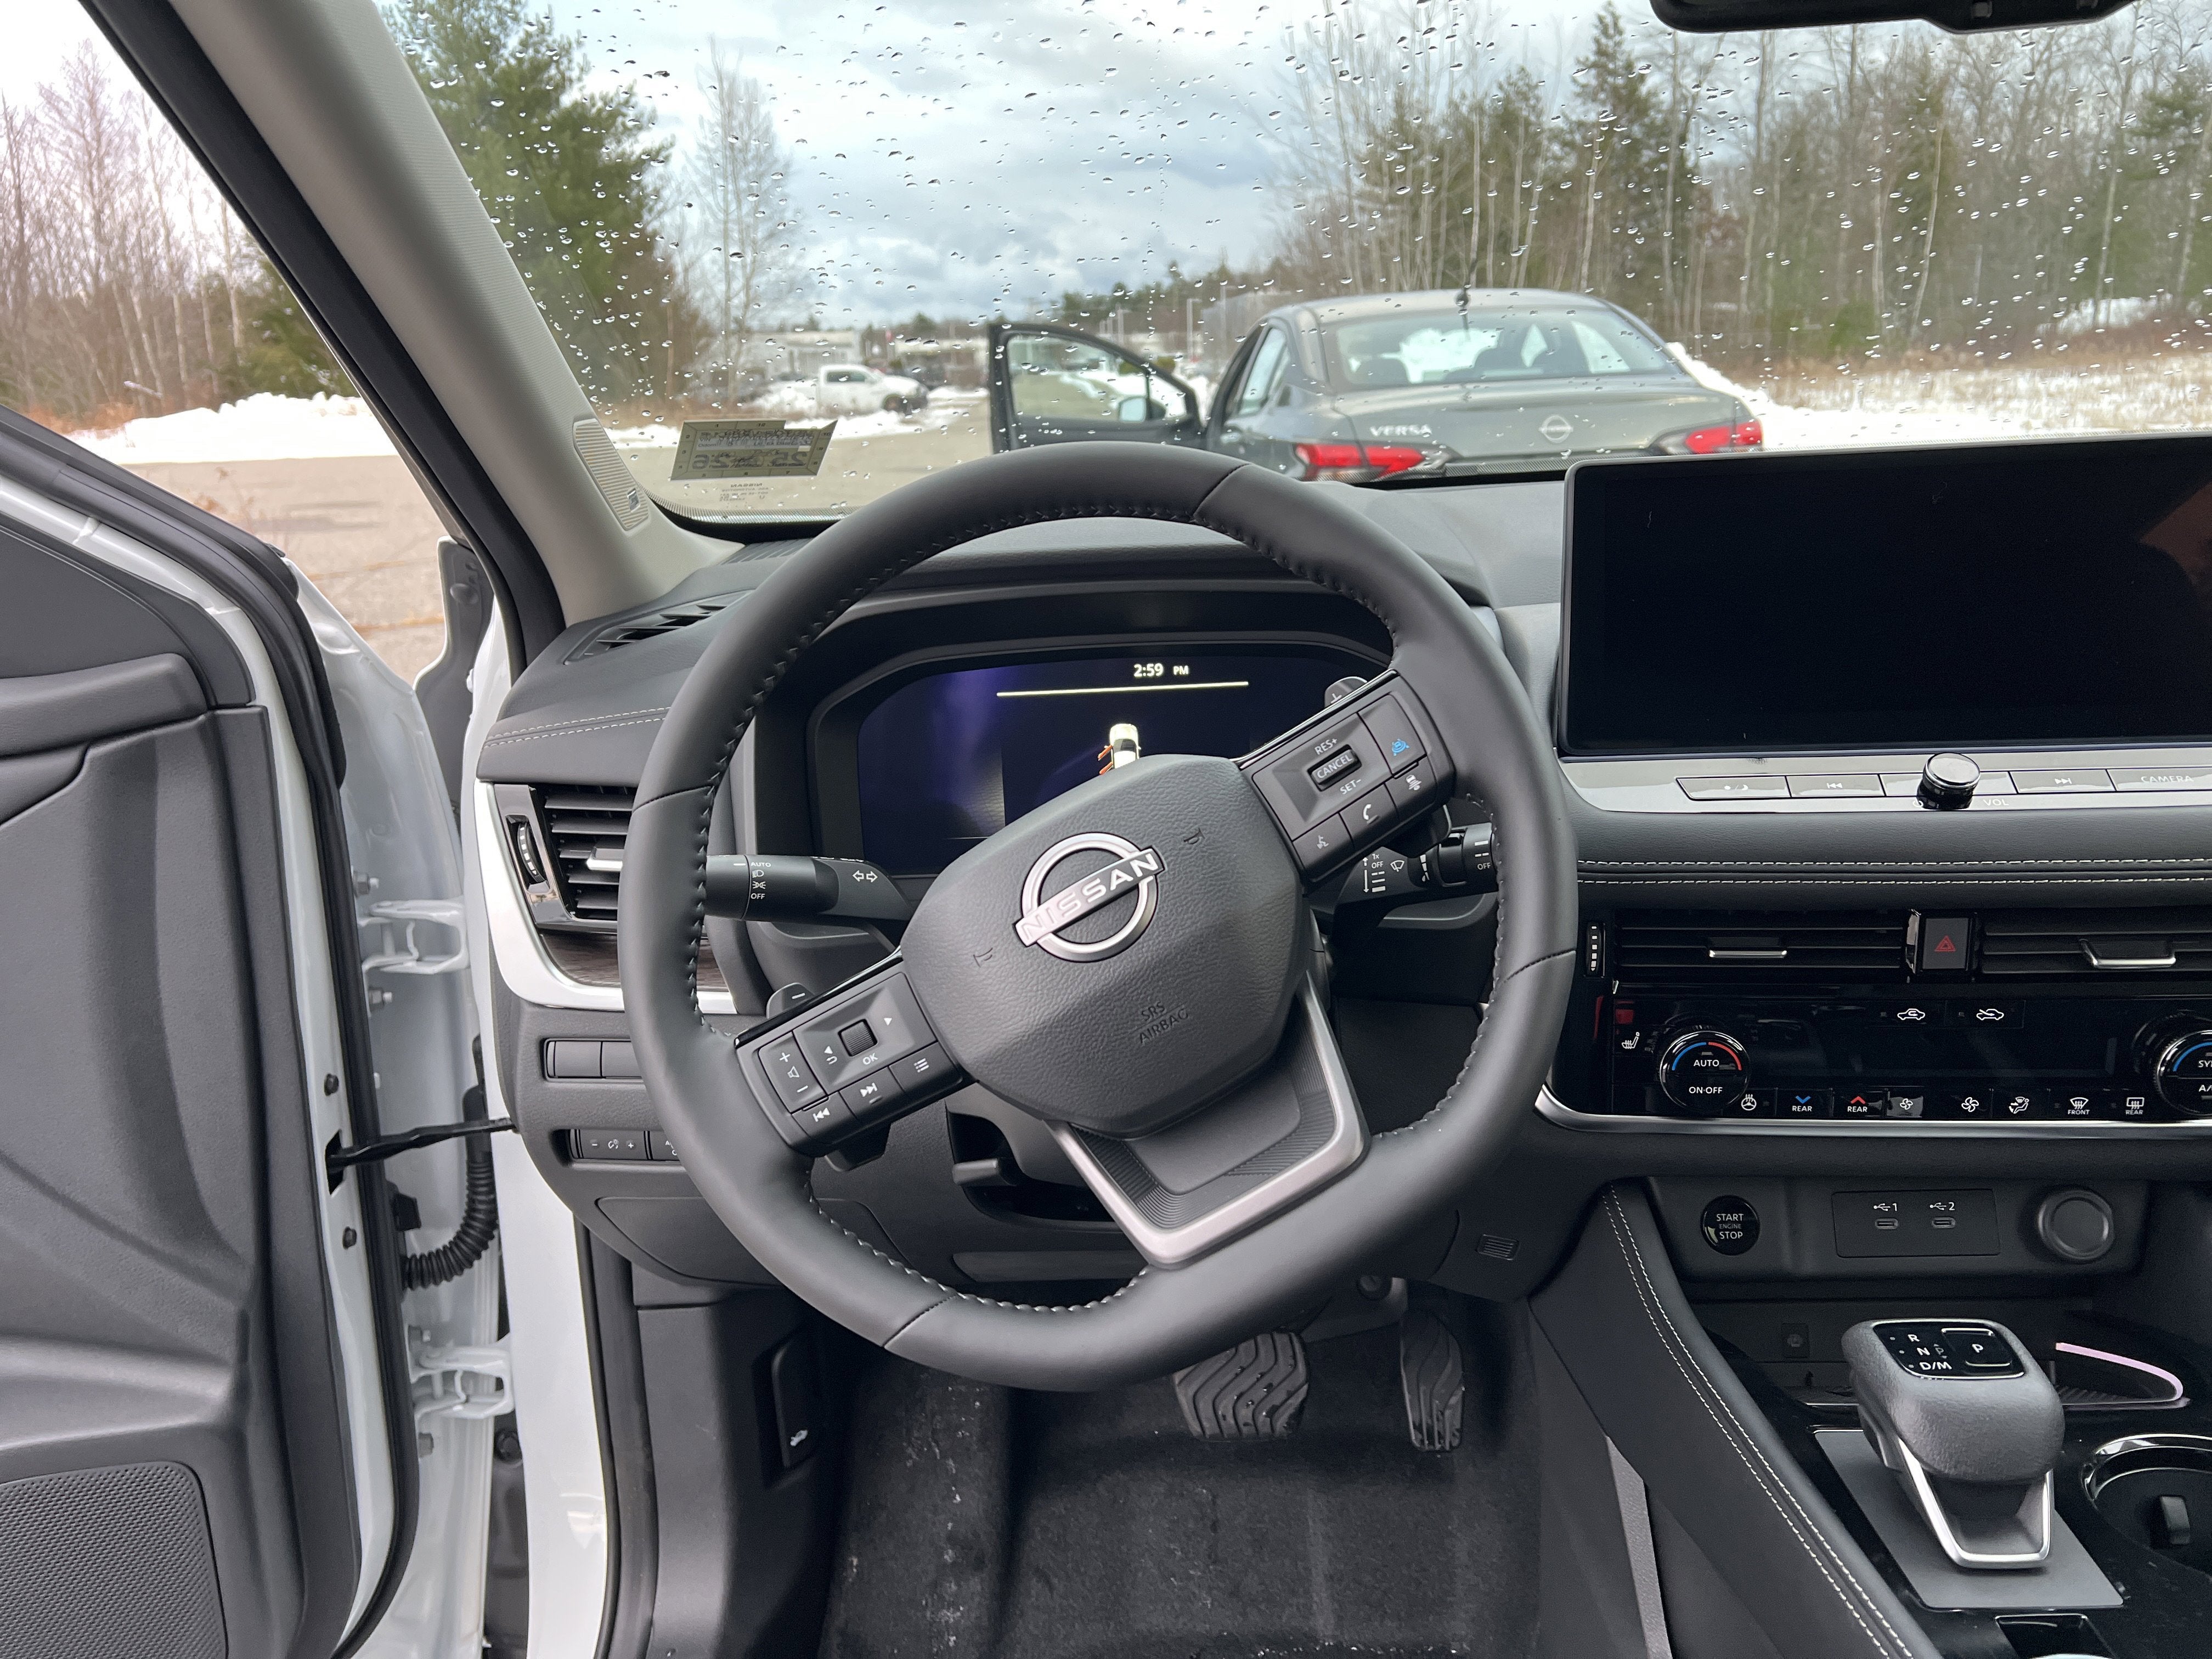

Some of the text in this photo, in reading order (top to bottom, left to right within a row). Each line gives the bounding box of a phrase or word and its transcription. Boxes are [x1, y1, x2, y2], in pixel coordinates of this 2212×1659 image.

[1370, 424, 1432, 437] VERSA
[1133, 663, 1189, 677] 2:59 PM
[1314, 737, 1338, 755] RES+
[1317, 754, 1353, 780] CANCEL
[1477, 862, 1491, 870] OFF
[1020, 853, 1159, 941] NISSAN
[1140, 1001, 1166, 1022] SRS
[1139, 1007, 1189, 1043] AIRBAG
[862, 1053, 878, 1065] OK
[1948, 1201, 1955, 1210] 2
[1716, 1213, 1744, 1222] START
[1719, 1231, 1743, 1239] STOP
[1916, 1347, 1931, 1356] N
[1972, 1344, 1984, 1353] P
[1919, 1362, 1953, 1370] D/M
